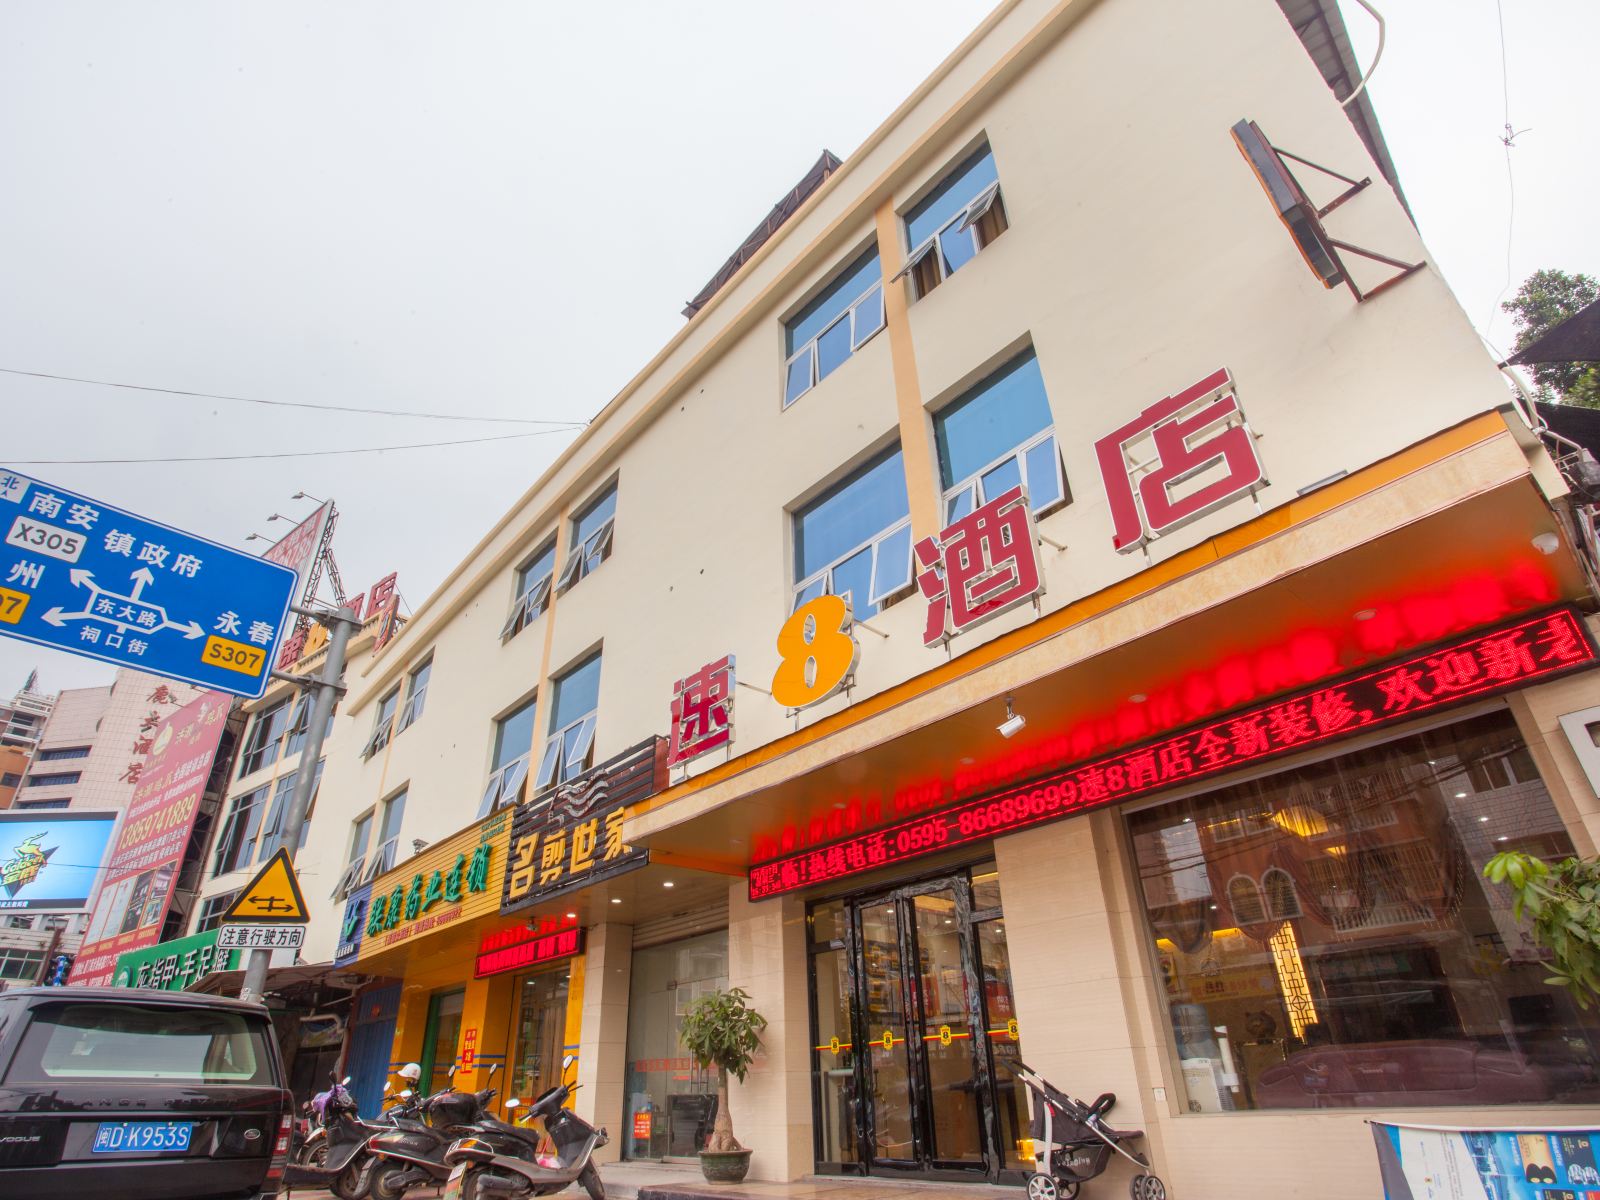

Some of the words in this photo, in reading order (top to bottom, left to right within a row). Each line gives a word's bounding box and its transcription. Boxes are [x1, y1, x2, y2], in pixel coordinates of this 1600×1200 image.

[1, 476, 19, 490] 北
[27, 491, 100, 530] 南安
[14, 524, 79, 555] X305
[104, 529, 203, 578] 镇政府
[6, 559, 46, 589] 州
[667, 367, 1268, 770] 速8酒店
[0, 591, 22, 615] 7
[95, 599, 157, 627] 东大路
[80, 625, 149, 656] 祠口街
[214, 610, 275, 646] 永春
[209, 644, 261, 670] S307
[510, 806, 632, 899] 名剪世家
[222, 927, 301, 947] 注意行驶方向
